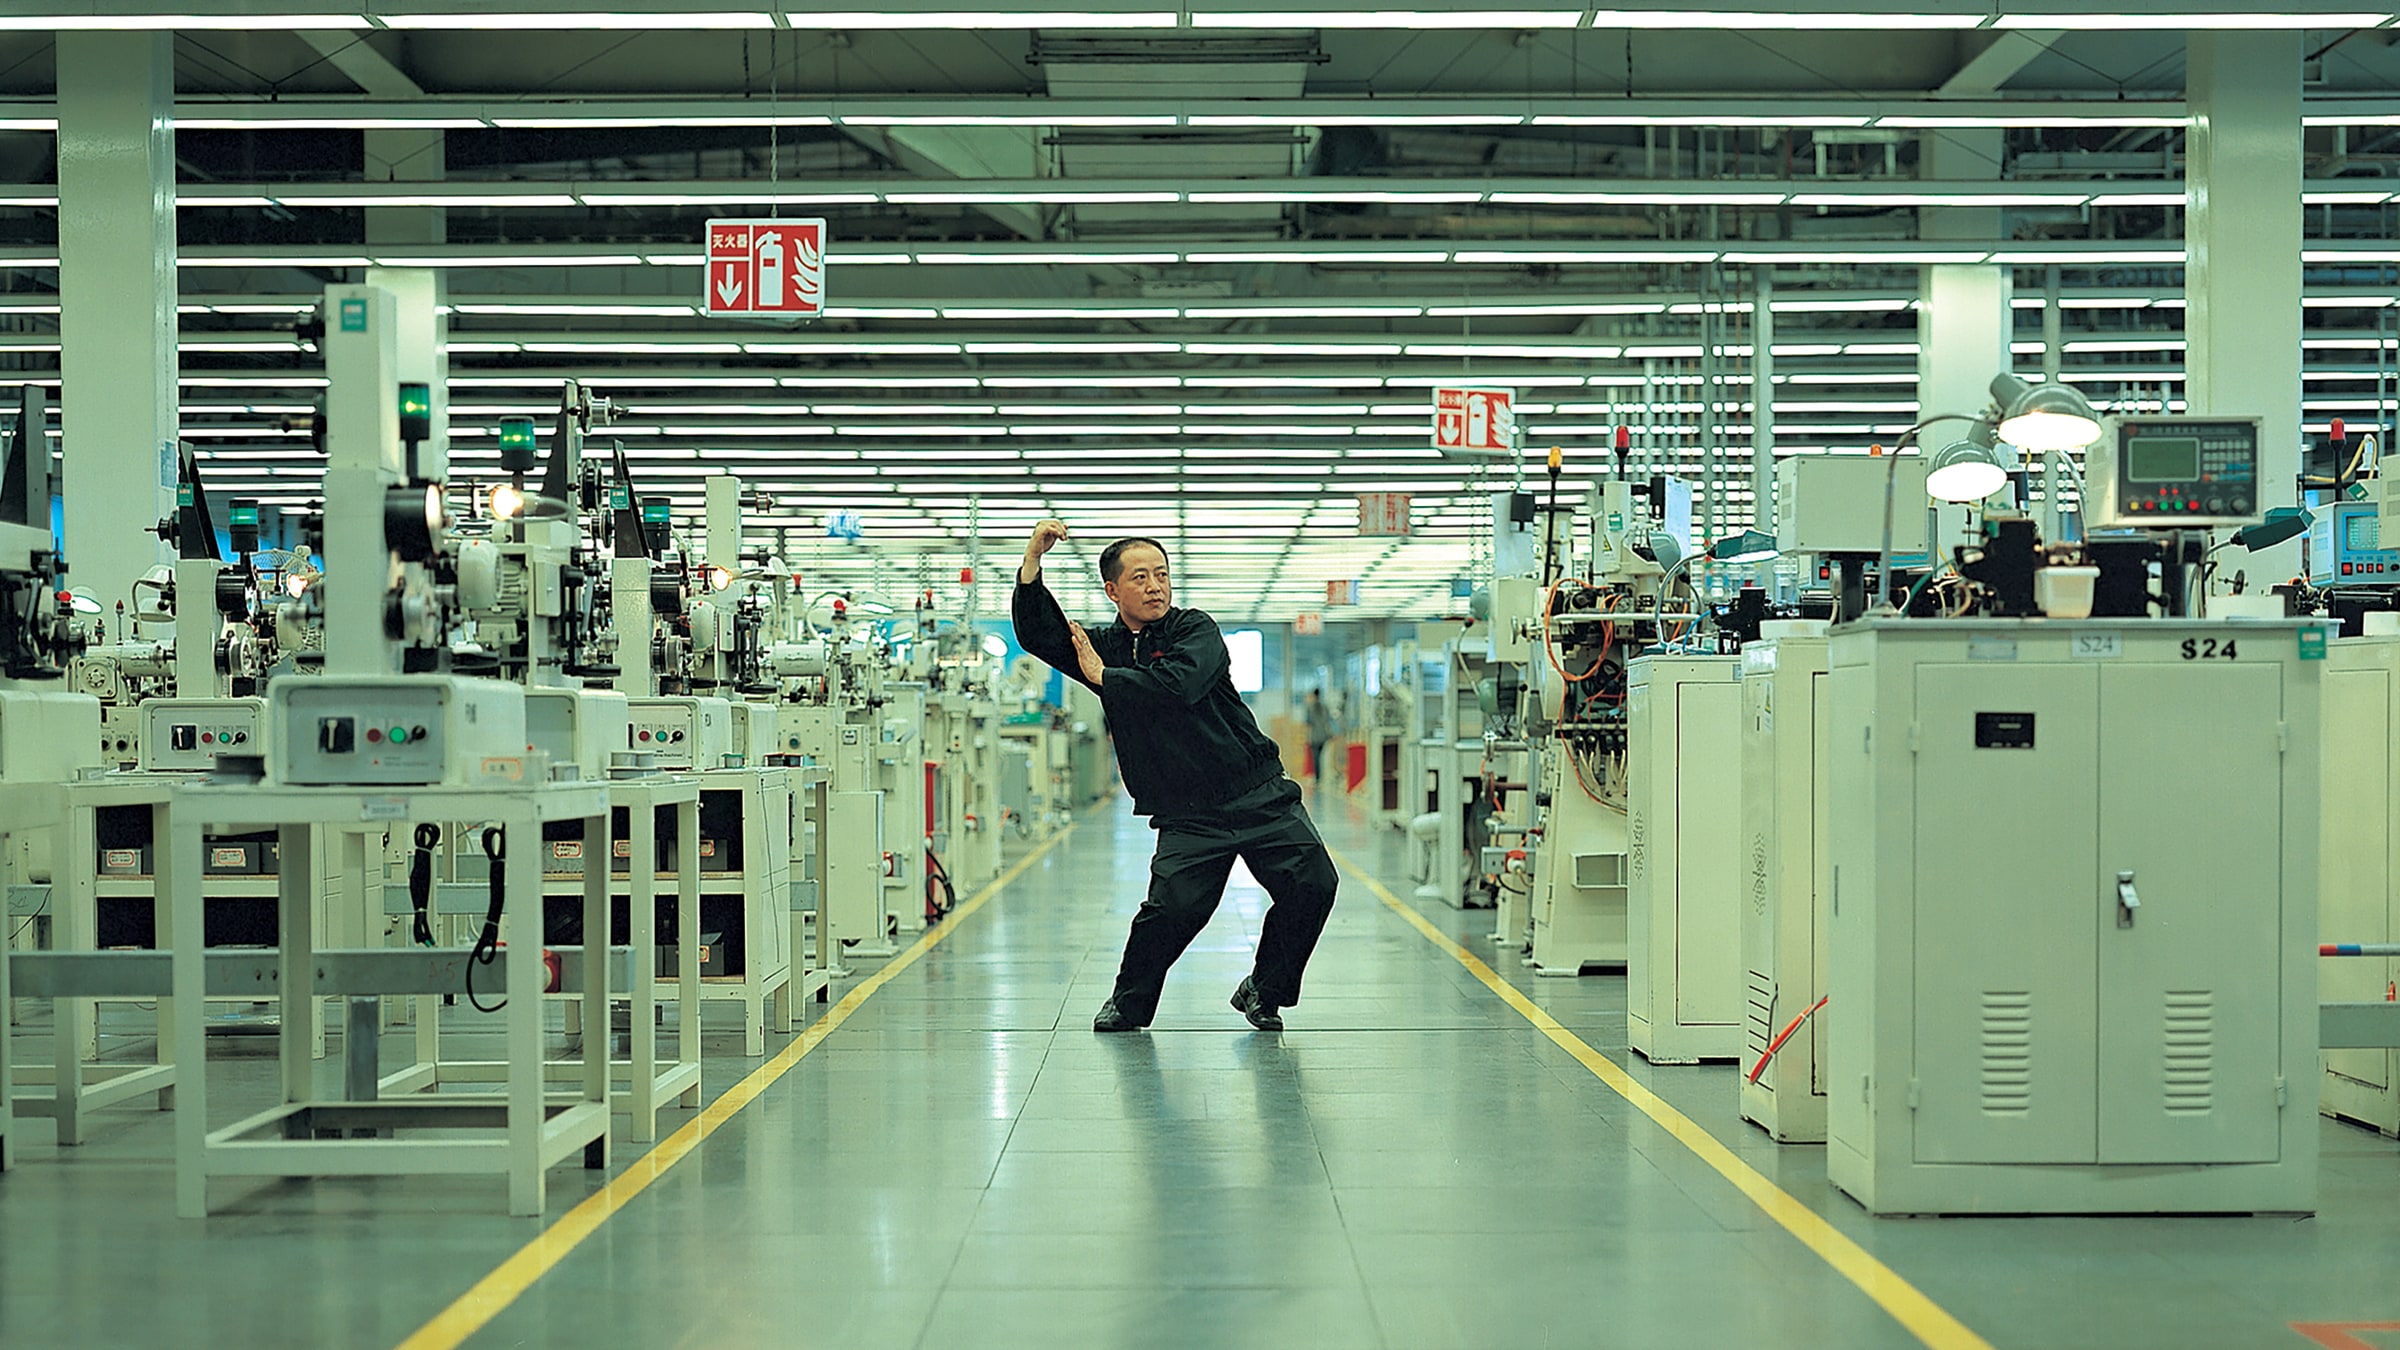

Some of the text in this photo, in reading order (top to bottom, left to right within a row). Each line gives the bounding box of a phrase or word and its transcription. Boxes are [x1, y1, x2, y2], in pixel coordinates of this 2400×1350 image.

[712, 234, 748, 248] 灭火器
[2079, 636, 2113, 653] S24
[2181, 638, 2237, 660] S24
